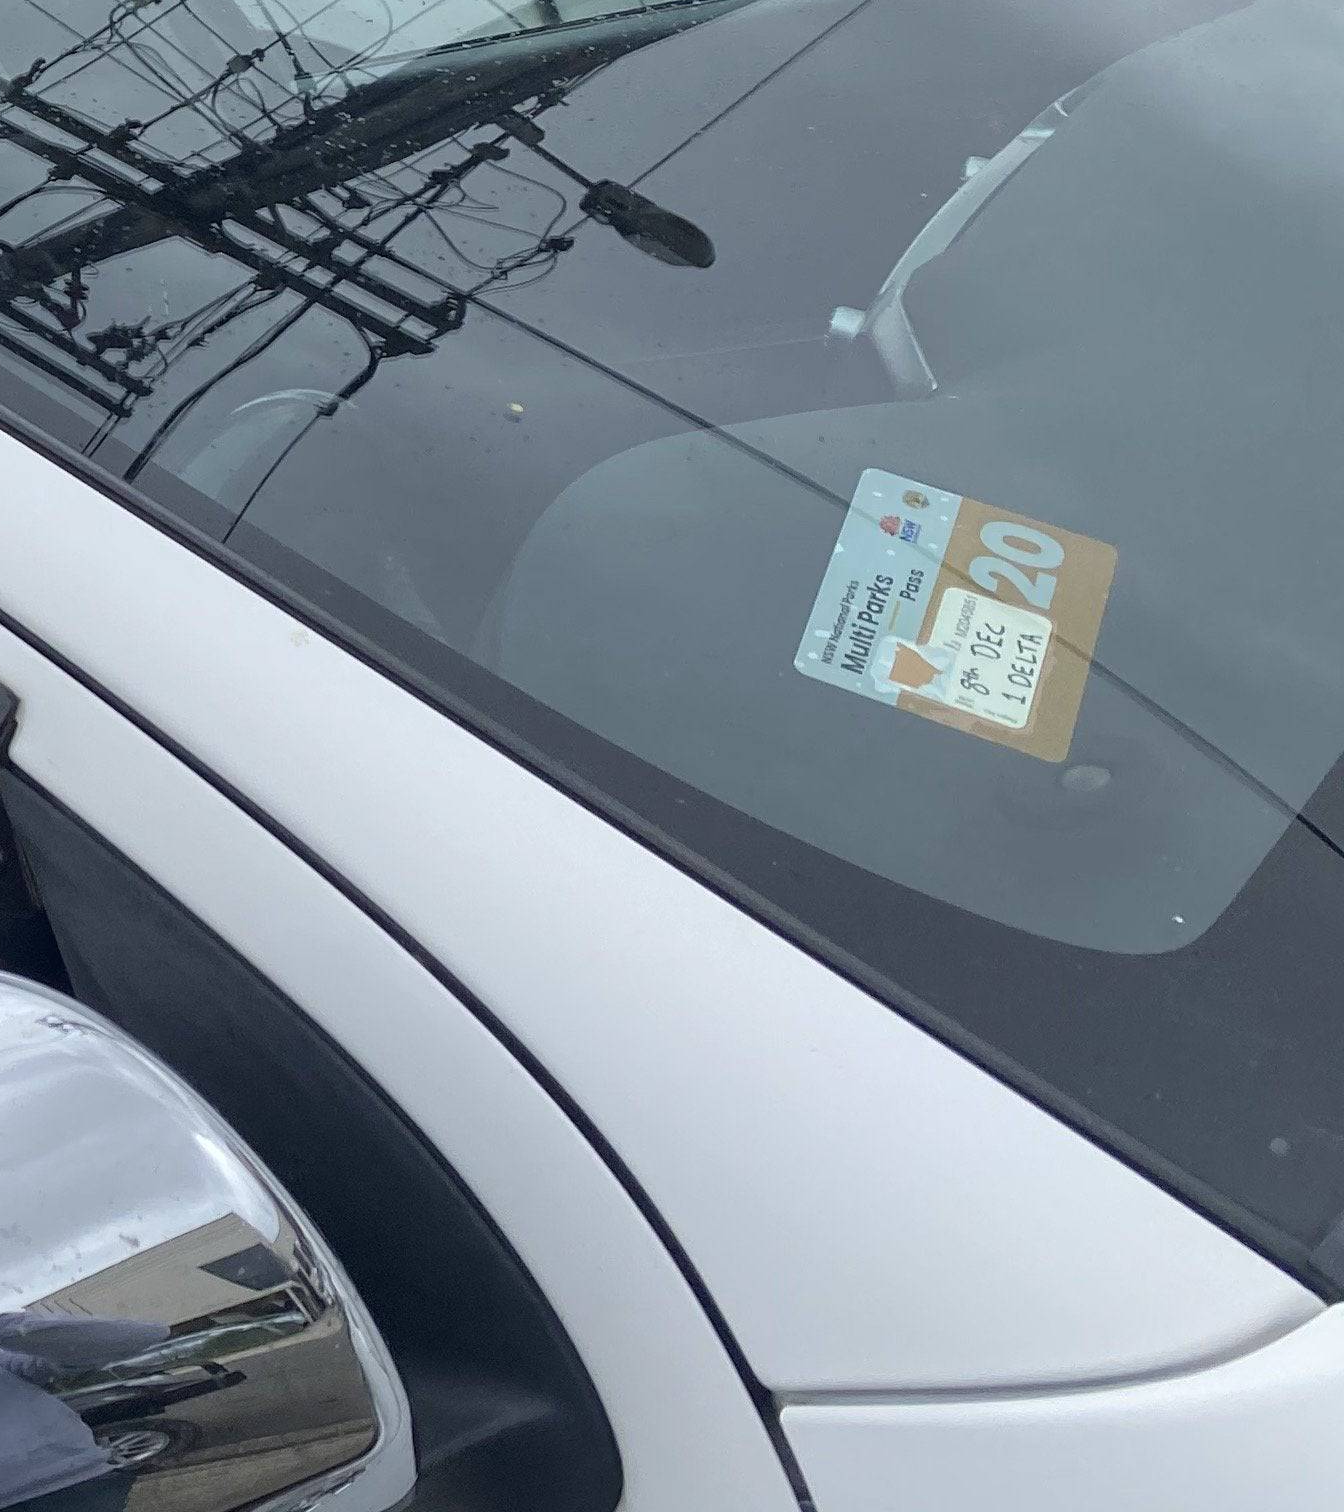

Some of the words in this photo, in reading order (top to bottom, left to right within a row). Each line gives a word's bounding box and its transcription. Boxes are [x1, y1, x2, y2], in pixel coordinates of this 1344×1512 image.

[900, 519, 917, 543] NSW
[968, 520, 1066, 610] 20
[899, 568, 925, 602] Pass
[820, 641, 838, 665] NSW
[841, 579, 860, 605] Parks
[970, 622, 1006, 660] DEC
[1007, 633, 1043, 689] DELTA
[960, 667, 991, 696] 8th
